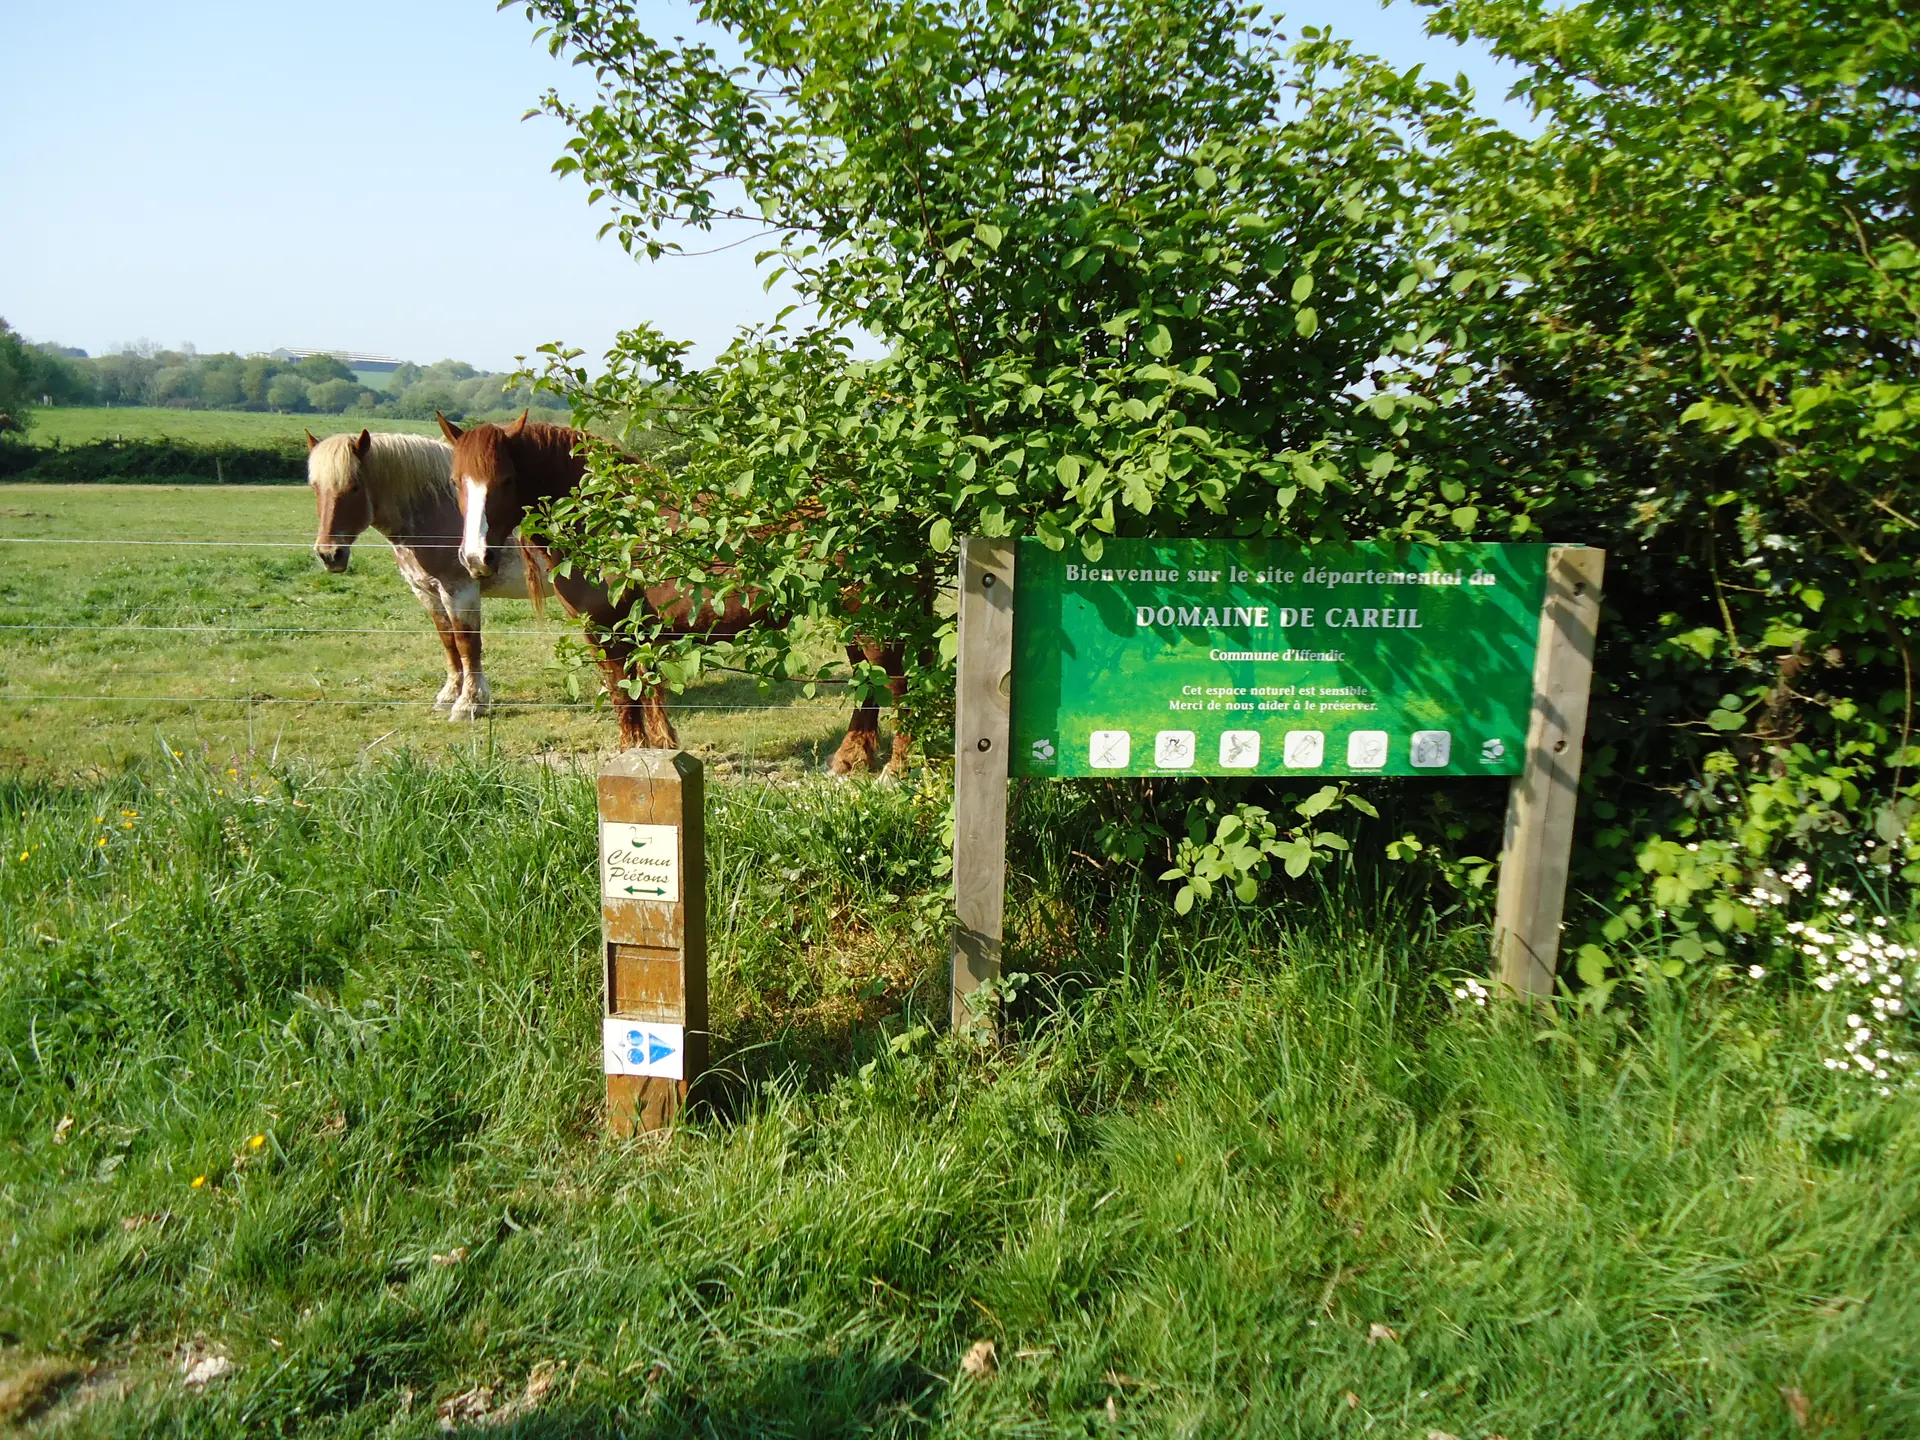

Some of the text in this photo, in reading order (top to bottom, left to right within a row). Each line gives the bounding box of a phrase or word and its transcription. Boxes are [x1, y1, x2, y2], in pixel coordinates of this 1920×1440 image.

[1066, 564, 1496, 589] Bienvenue sur le site départemental du
[1136, 606, 1423, 628] DOMAINE DE CAREIL
[1209, 649, 1345, 662] Commune d'Iffendic
[1182, 685, 1368, 698] Cet espace naturel est sensible
[1169, 700, 1379, 713] Merci de nous aider à le préserver.
[607, 849, 672, 867] Chemin
[608, 866, 669, 883] Piétons
